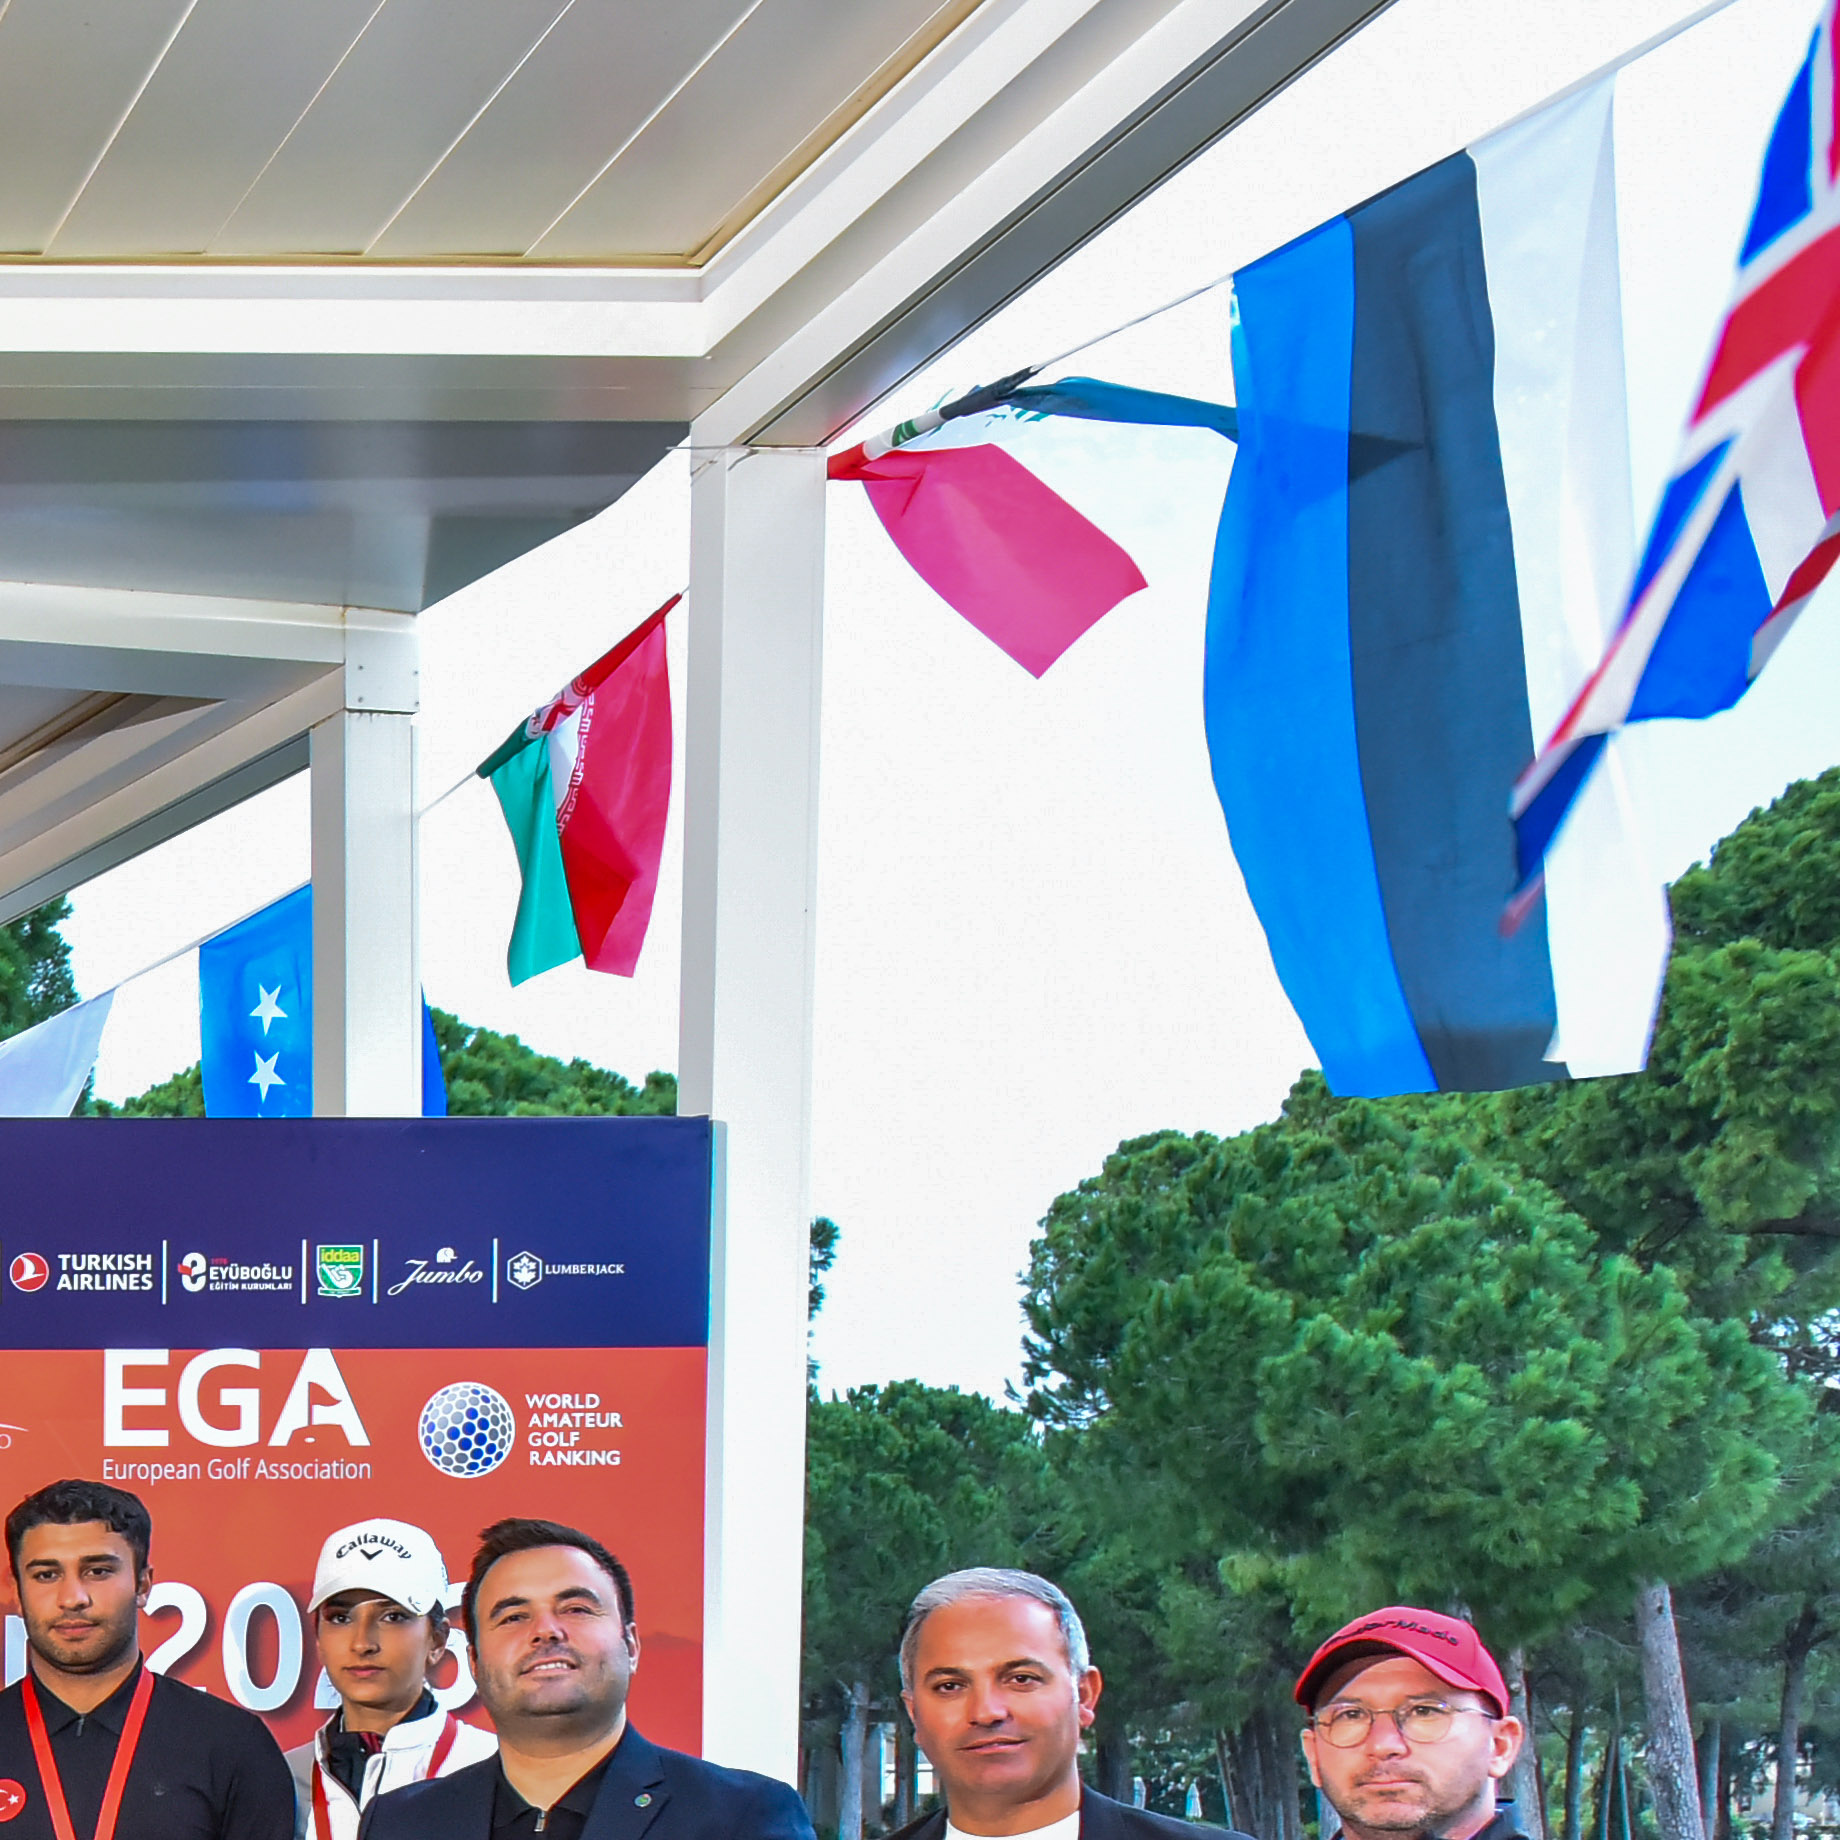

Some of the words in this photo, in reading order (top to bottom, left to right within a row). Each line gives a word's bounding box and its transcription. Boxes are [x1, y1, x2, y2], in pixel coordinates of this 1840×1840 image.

[58, 1253, 152, 1271] TURKISH
[321, 1248, 360, 1263] iddaa
[209, 1263, 293, 1280] EYÜBOĞLU
[387, 1259, 484, 1296] Jumbo
[545, 1264, 625, 1275] LUMBERJACK
[56, 1273, 154, 1290] AIRLINES
[241, 1282, 293, 1290] KURUMLARI
[104, 1348, 371, 1447] EGA
[525, 1393, 601, 1409] WORLD
[528, 1412, 624, 1428] AMATEUR
[528, 1431, 580, 1447] GOLF
[529, 1450, 621, 1466] RANKING
[103, 1458, 201, 1486] European
[206, 1457, 250, 1480] Golf
[254, 1457, 372, 1480] Association
[335, 1533, 412, 1559] Callaway
